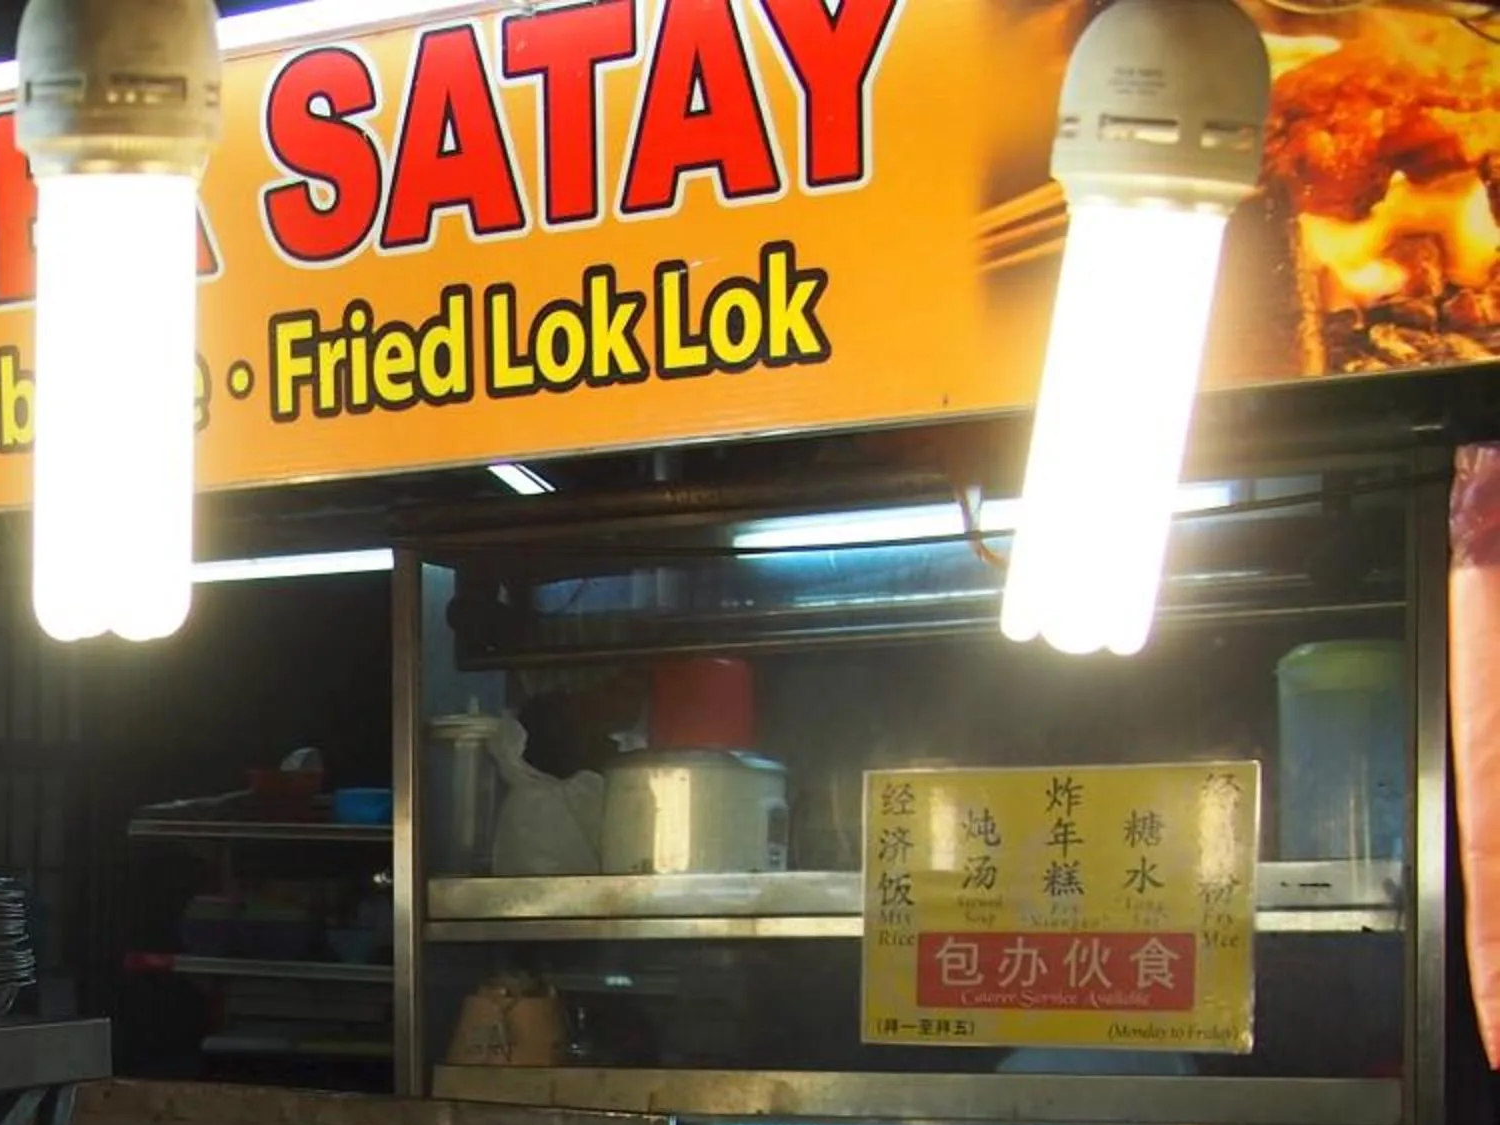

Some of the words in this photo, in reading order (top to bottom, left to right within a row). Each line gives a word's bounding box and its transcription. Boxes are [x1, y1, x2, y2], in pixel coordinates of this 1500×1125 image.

[263, 0, 900, 262] SATAY
[272, 287, 470, 419] Fried
[489, 267, 642, 396] Lok
[656, 243, 829, 372] Lok
[878, 782, 916, 907] 经济饭
[1042, 776, 1086, 898] 炸年糕
[1123, 808, 1166, 895] 糖水
[878, 928, 915, 947] Rice
[934, 936, 1182, 990] 包办伙食
